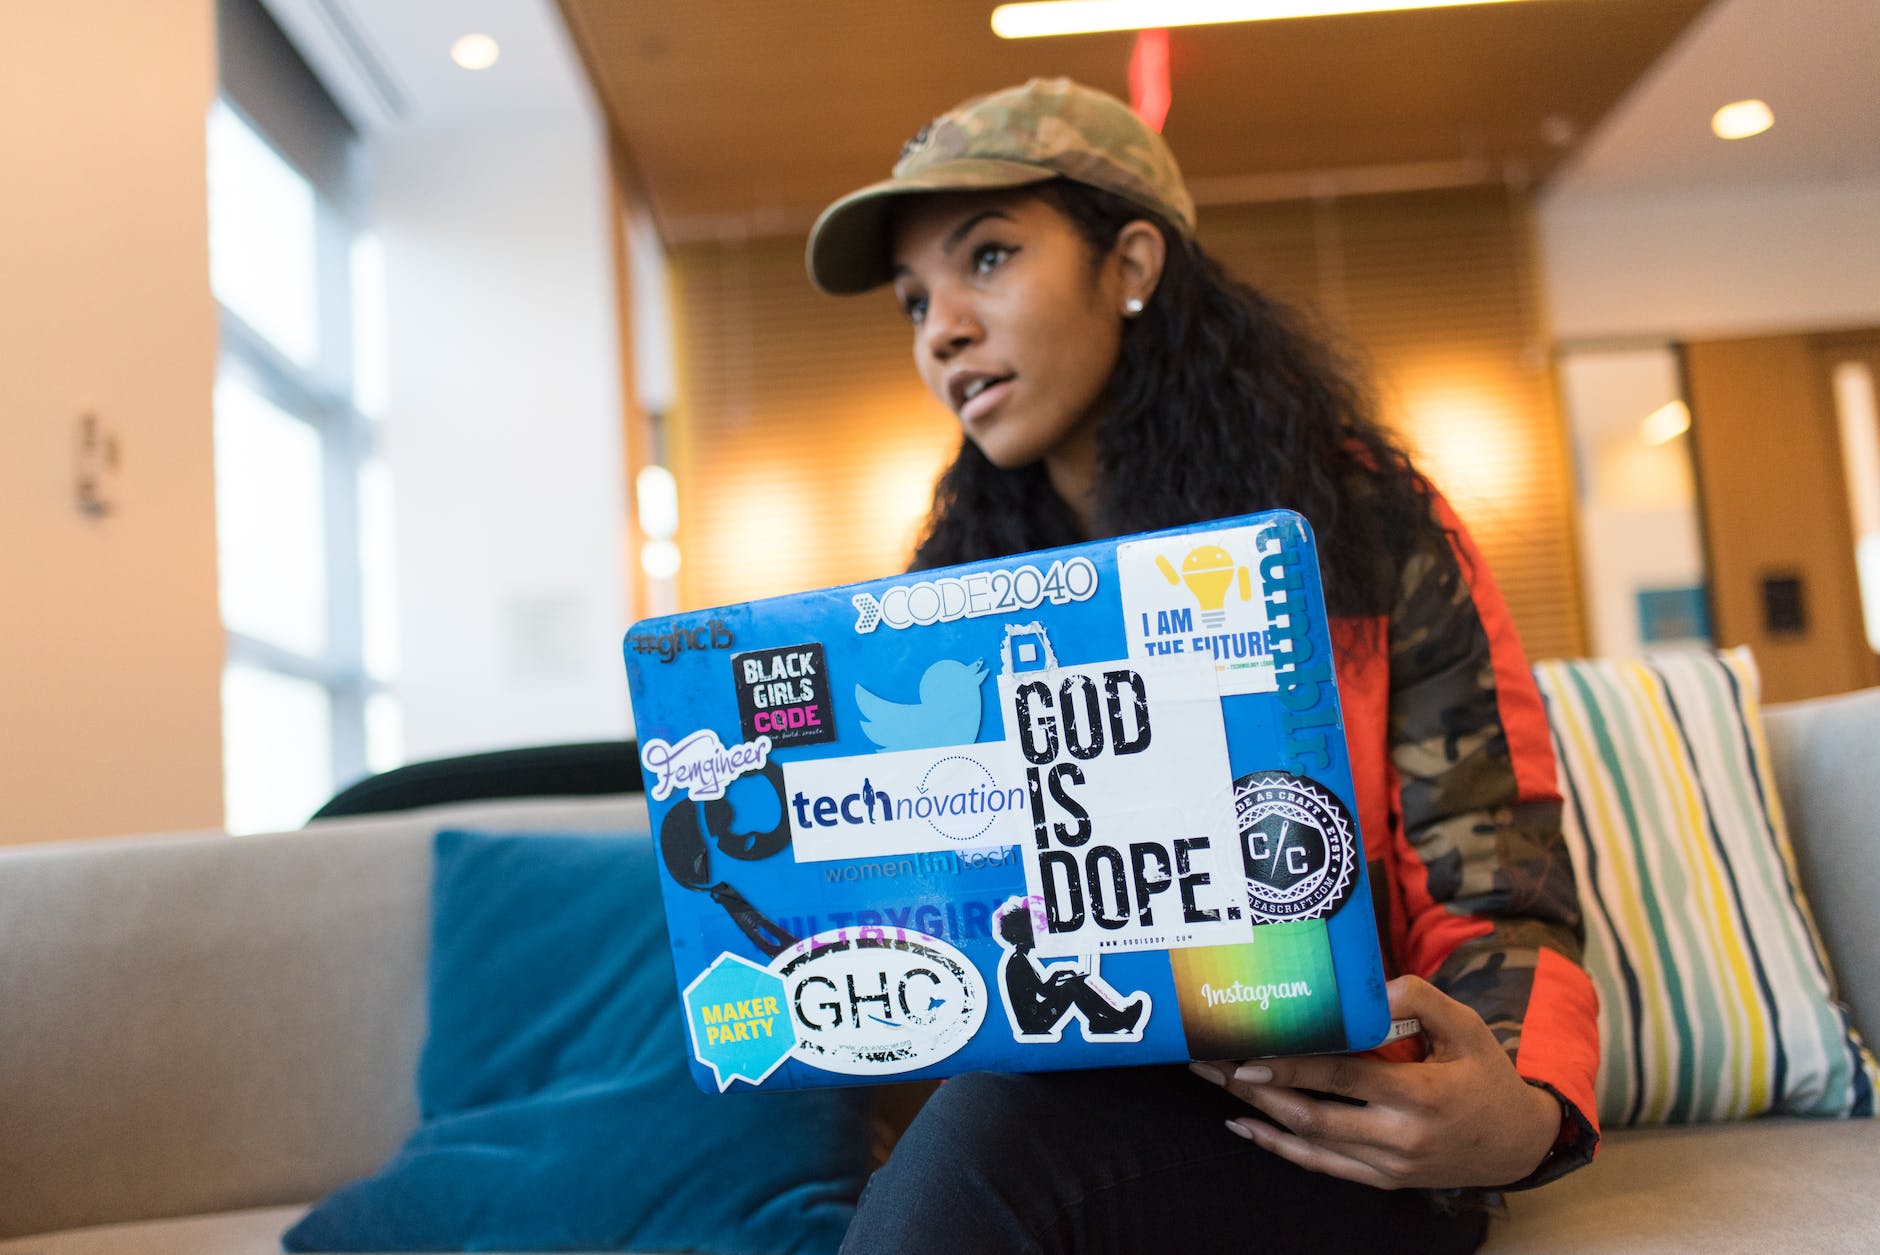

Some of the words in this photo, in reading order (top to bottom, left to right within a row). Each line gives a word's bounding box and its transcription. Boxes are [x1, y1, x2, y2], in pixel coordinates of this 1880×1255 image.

[882, 561, 1094, 626] CODE2040
[1141, 612, 1150, 637] I
[1158, 608, 1193, 635] AM
[632, 619, 734, 664] #ghc15
[743, 652, 816, 684] BLACK
[753, 678, 814, 708] GIRLS
[754, 704, 821, 733] CODE
[1015, 669, 1152, 765] GOD
[647, 735, 766, 795] Femgineer
[792, 777, 1024, 829] technovation
[1026, 762, 1092, 849] IS
[1256, 790, 1273, 801] AS
[1278, 790, 1321, 816] CRAFT
[1325, 826, 1341, 862] ETSY
[1038, 836, 1242, 934] DOPE.
[701, 996, 780, 1025] MAKER
[794, 967, 942, 1032] GHC
[1201, 980, 1313, 1010] Instagram
[706, 1017, 774, 1046] PARTY
